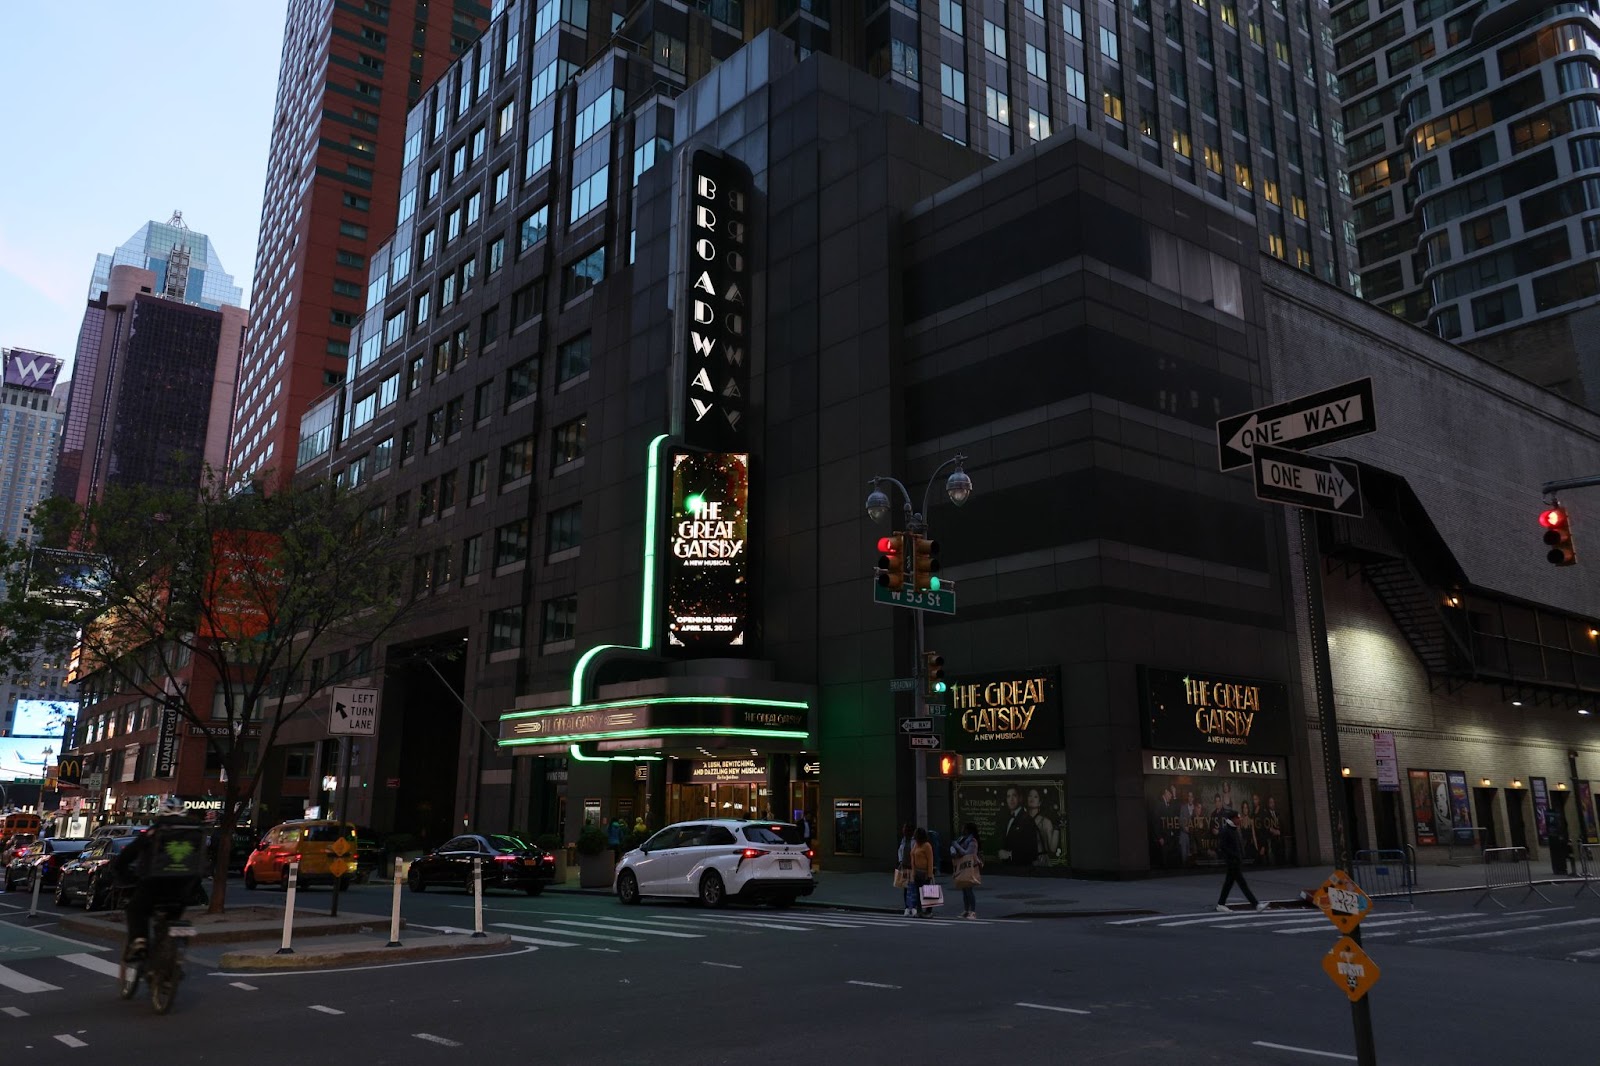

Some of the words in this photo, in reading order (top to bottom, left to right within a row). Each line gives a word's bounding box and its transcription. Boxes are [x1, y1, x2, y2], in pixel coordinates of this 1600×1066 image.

[690, 174, 717, 422] BROADWAY
[14, 356, 52, 382] W
[1241, 420, 1283, 448] ONE
[1304, 400, 1350, 432] WAY
[1271, 463, 1302, 489] ONE
[1315, 472, 1344, 497] WAY
[692, 501, 723, 520] THE
[678, 520, 736, 539] GREAT
[673, 539, 744, 558] GATSBY
[891, 591, 901, 600] W
[906, 588, 923, 604] 53
[927, 592, 941, 607] St
[680, 624, 701, 632] APRIL
[714, 624, 733, 632] 2024
[352, 693, 375, 704] LEFT
[951, 683, 982, 709] THE
[984, 677, 1047, 707] GREAT
[1183, 678, 1212, 707] THE
[1213, 682, 1261, 712] GREAT
[350, 706, 374, 716] TURN
[961, 705, 1036, 733] GATSBY
[349, 720, 372, 729] LANE
[1195, 707, 1254, 736] GATSBY
[974, 734, 980, 742] A
[979, 733, 995, 741] NEW
[995, 732, 1025, 740] MUSICAL
[1207, 735, 1212, 743] A
[1212, 736, 1225, 744] NEW
[1225, 737, 1248, 746] MUSICAL
[693, 768, 704, 776] AND
[728, 767, 740, 775] NEW
[965, 755, 1049, 771] BROADWAY
[1152, 755, 1217, 772] BROADWAY
[1228, 759, 1278, 775] THEATRE
[1160, 816, 1180, 830] THE
